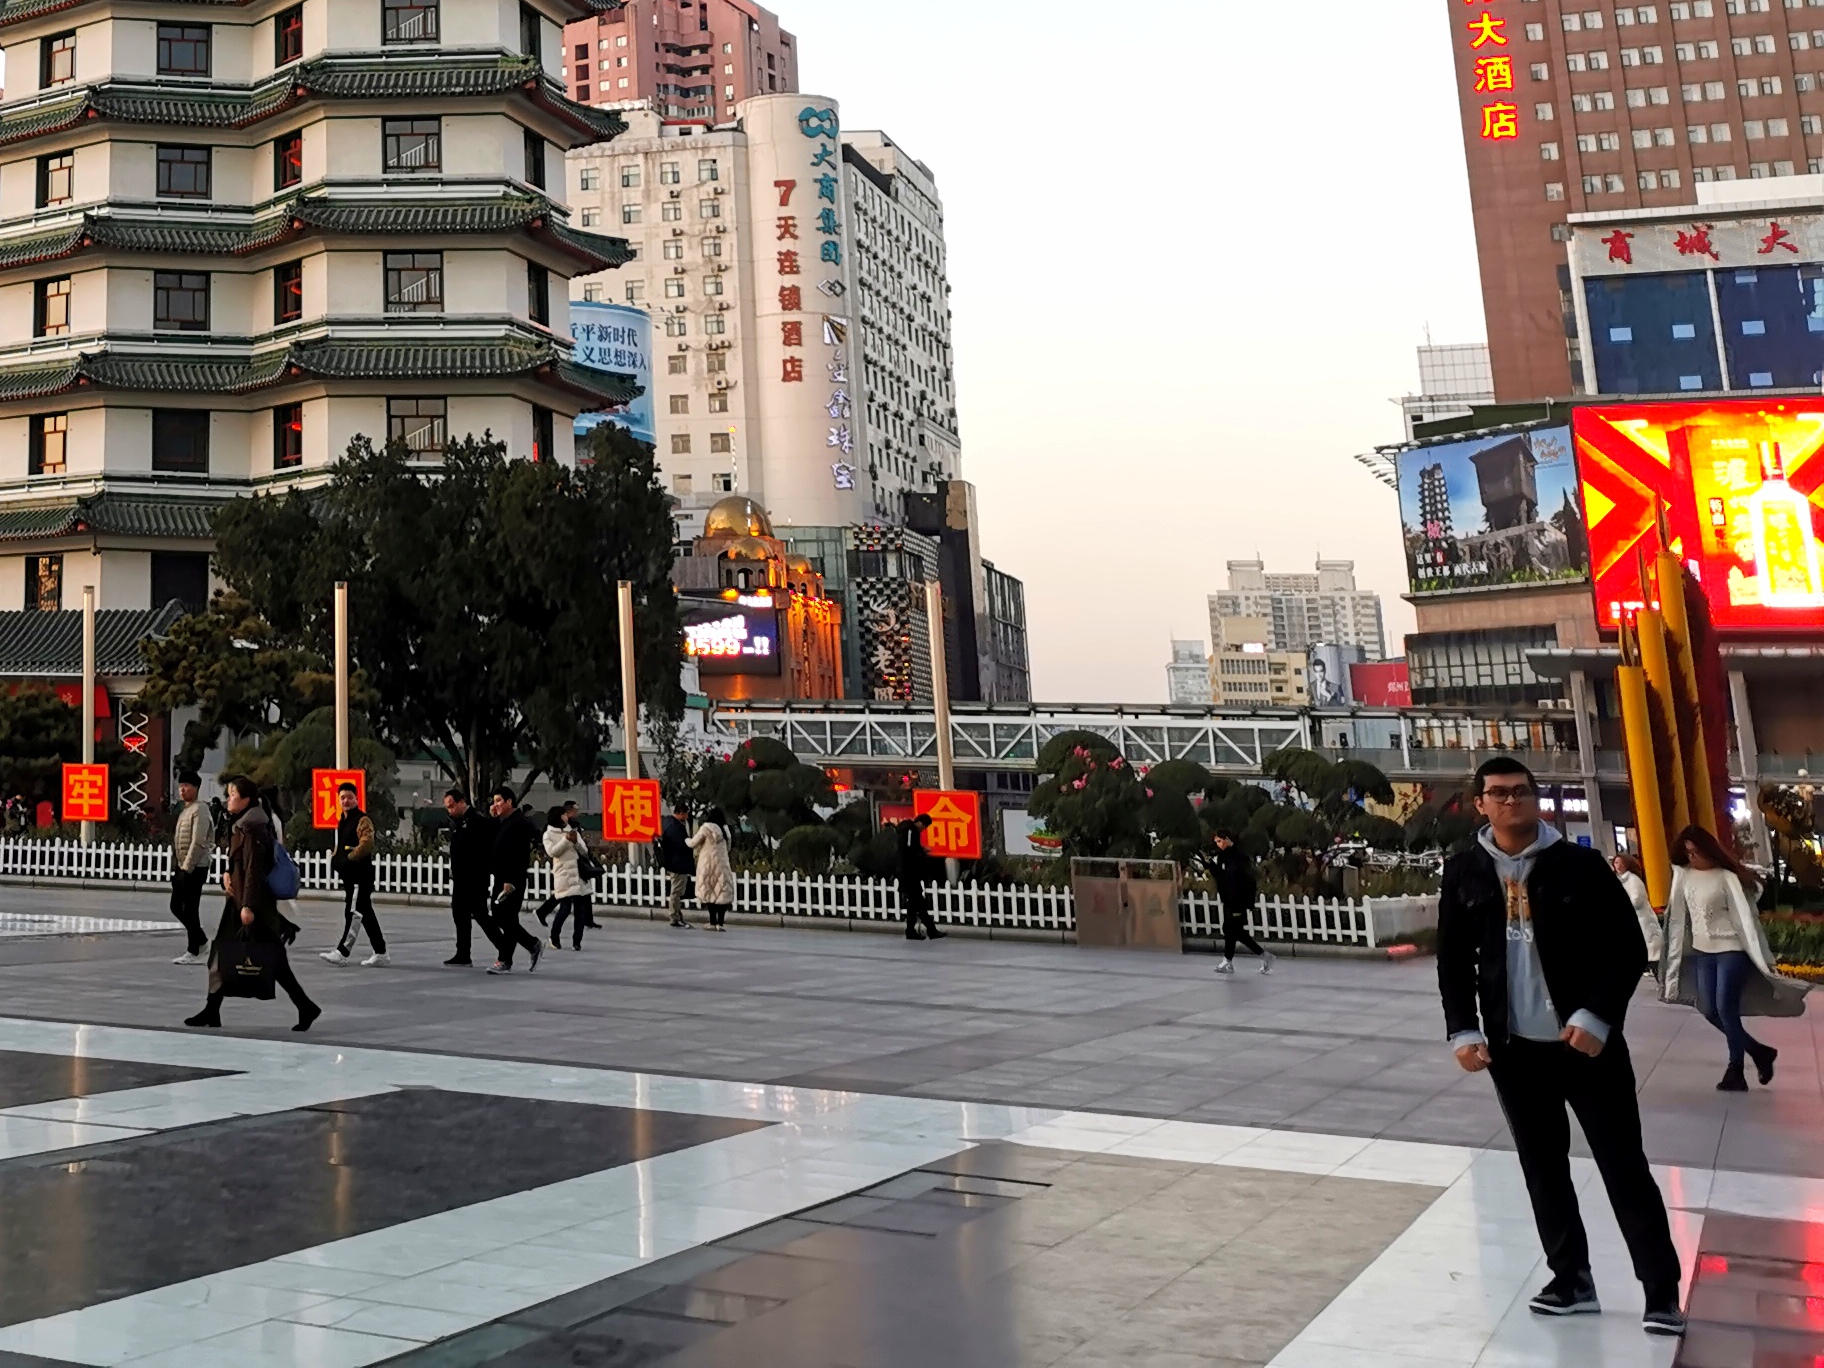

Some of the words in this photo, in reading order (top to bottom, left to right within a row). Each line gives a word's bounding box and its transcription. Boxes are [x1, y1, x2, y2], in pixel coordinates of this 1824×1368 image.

[810, 142, 843, 266] 大商集团
[773, 179, 803, 382] 7天连锁酒店
[572, 345, 647, 371] 义思想深入
[68, 768, 103, 816] 牢
[608, 784, 655, 837] 使
[926, 796, 973, 852] 命
